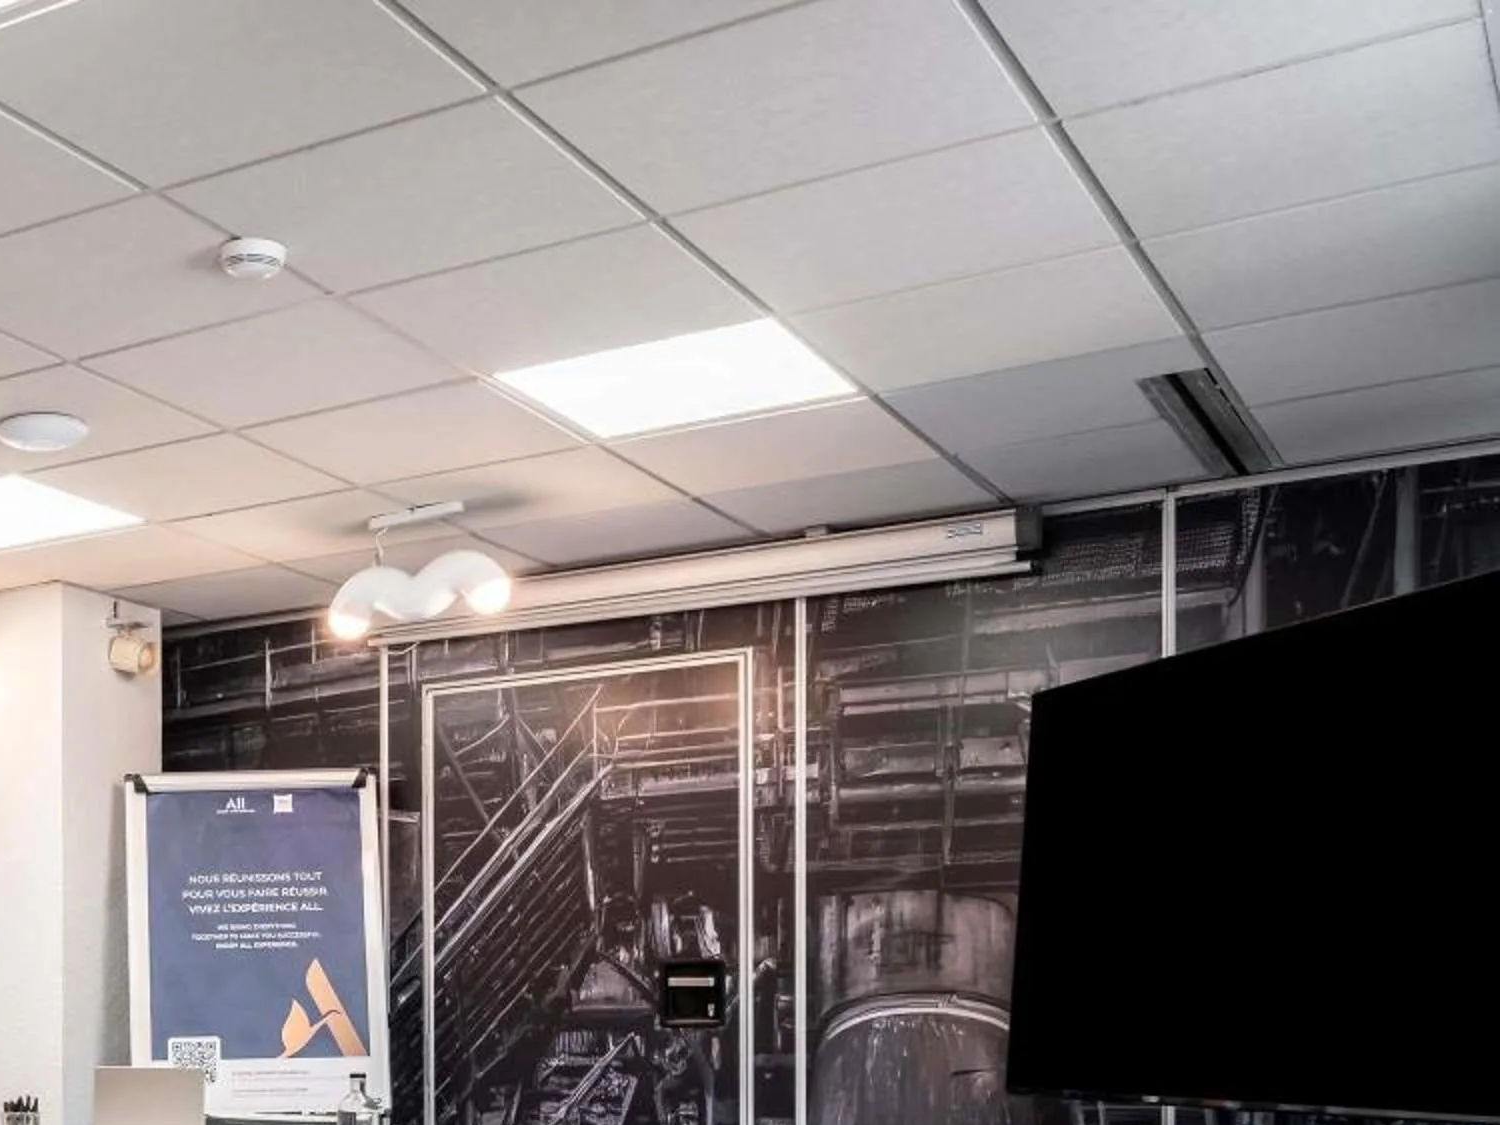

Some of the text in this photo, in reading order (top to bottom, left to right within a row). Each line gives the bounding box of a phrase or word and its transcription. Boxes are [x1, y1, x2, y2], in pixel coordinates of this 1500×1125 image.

[189, 875, 219, 885] NOUS
[294, 871, 323, 881] TOUT
[182, 889, 213, 899] POUR
[216, 889, 246, 899] VOUS
[248, 887, 279, 898] FAIRE
[189, 904, 220, 914] VIVEZ
